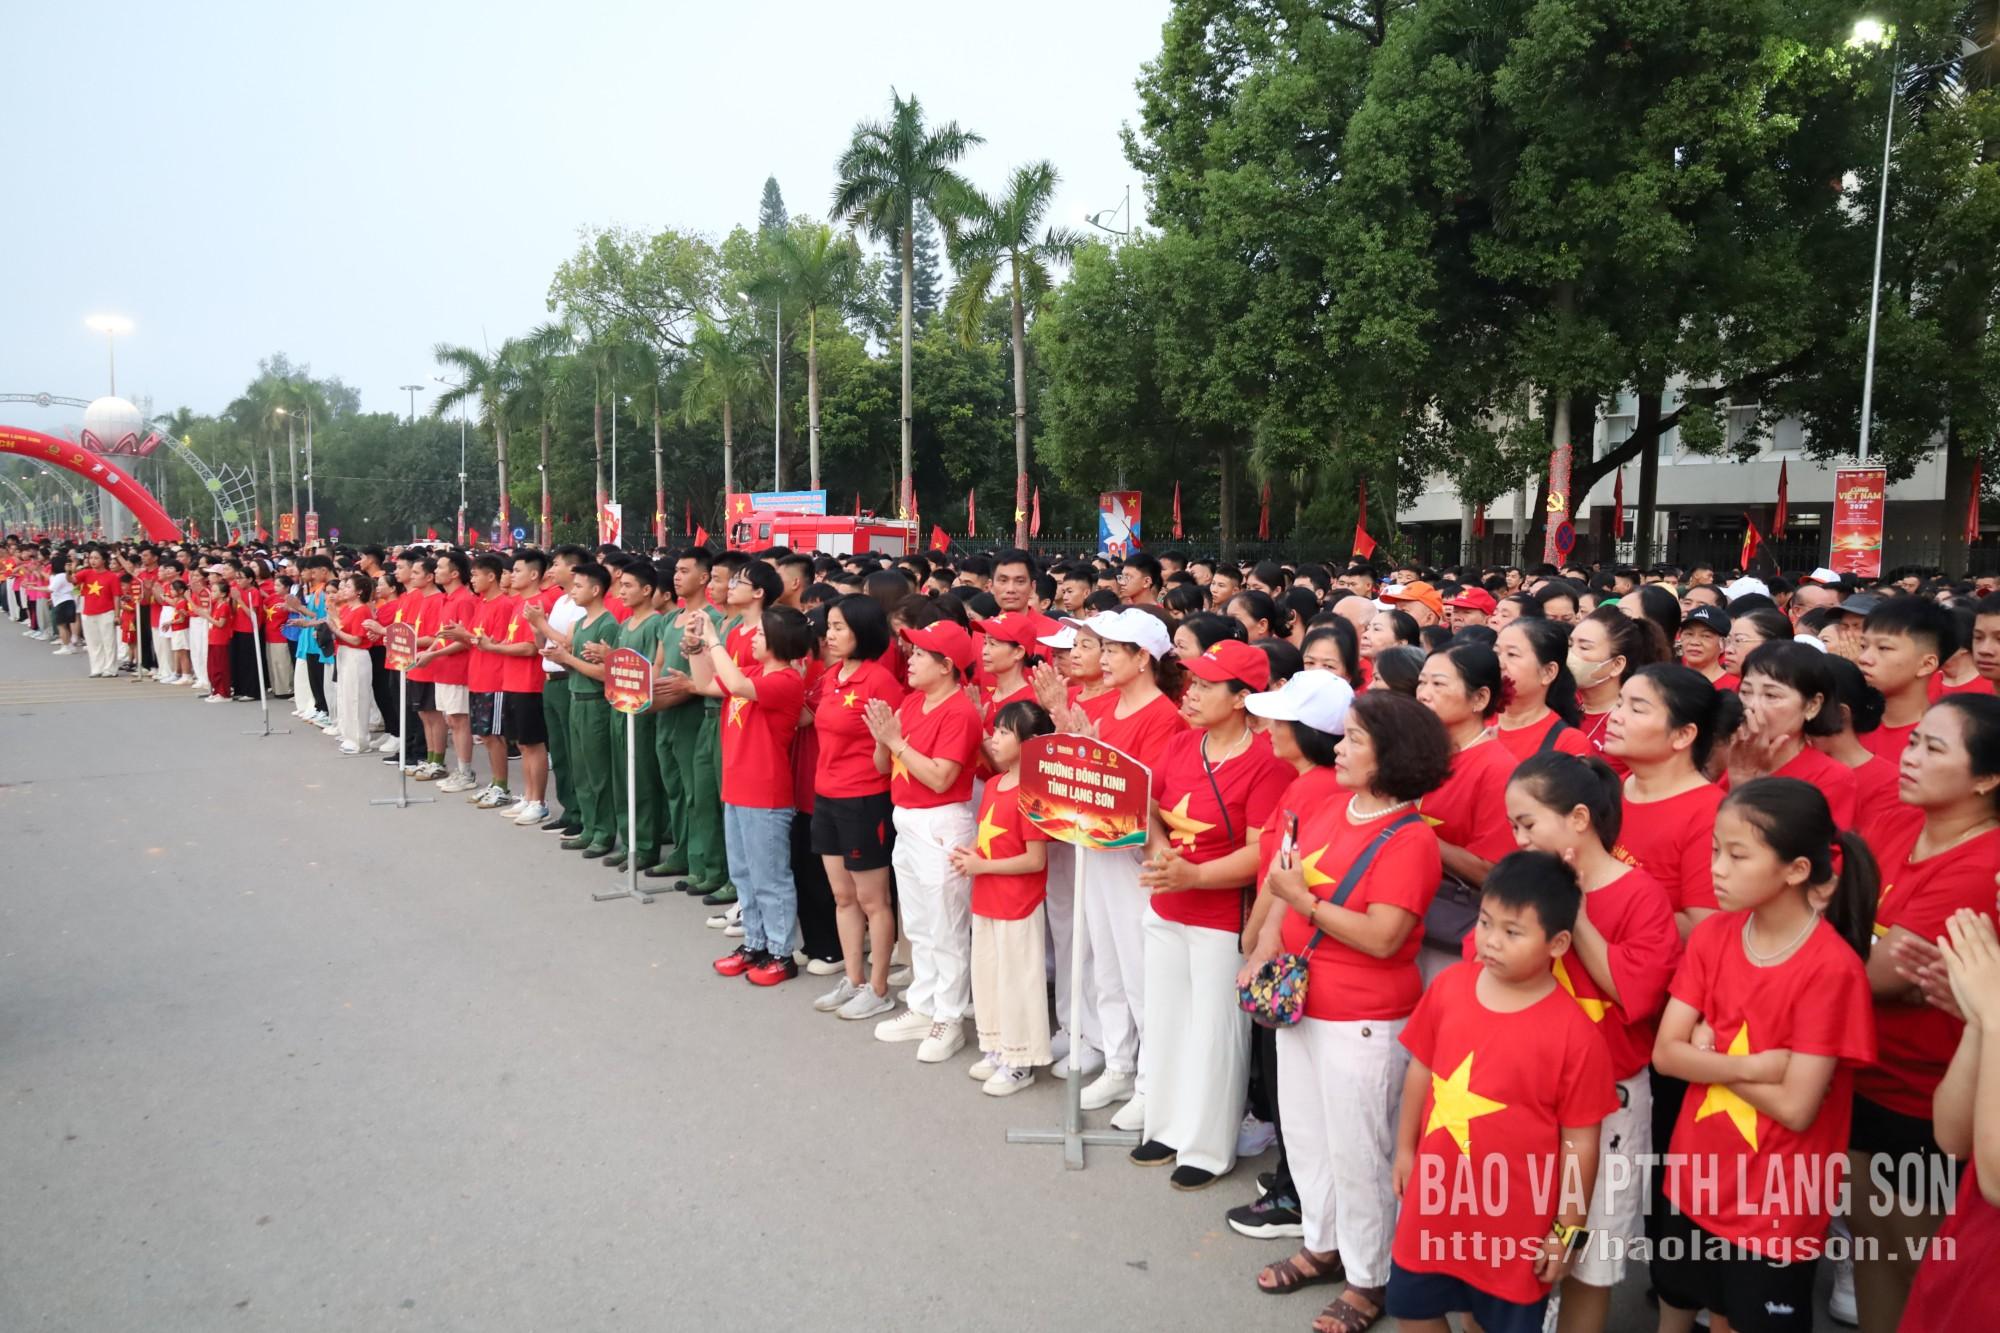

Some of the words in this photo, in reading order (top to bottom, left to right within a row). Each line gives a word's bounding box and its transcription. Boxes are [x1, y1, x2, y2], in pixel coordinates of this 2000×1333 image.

[1860, 492, 1881, 500] NAM
[1039, 760, 1074, 780] PHƯỜNG
[1075, 766, 1101, 784] ĐÔNG
[1103, 774, 1126, 792] KINH
[1048, 777, 1068, 799] TỈNH
[1069, 786, 1093, 804] LẠNG
[1095, 792, 1115, 809] SƠN
